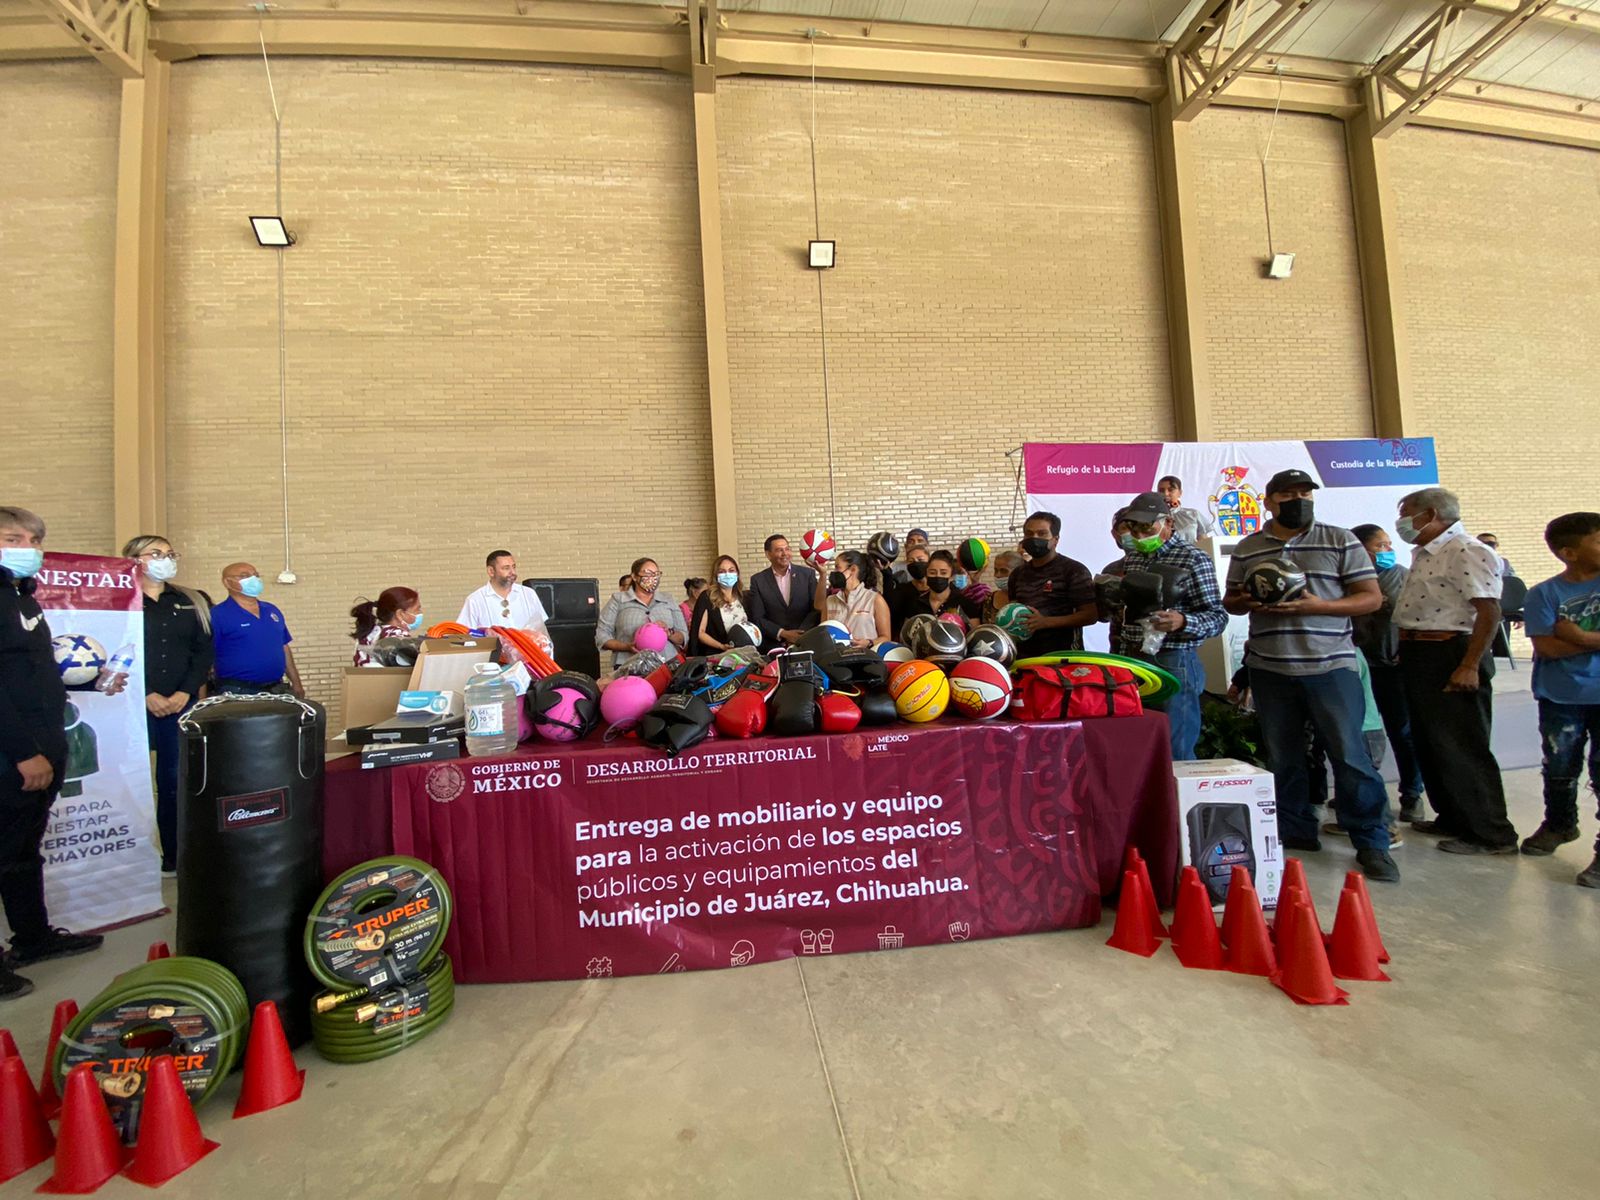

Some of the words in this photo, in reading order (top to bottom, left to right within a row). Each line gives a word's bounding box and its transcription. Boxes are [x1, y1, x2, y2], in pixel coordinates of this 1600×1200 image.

[1046, 464, 1079, 476] Refugio
[1081, 464, 1091, 474] de
[1093, 464, 1101, 474] la
[1103, 464, 1136, 474] Libertad
[1330, 460, 1364, 469] Custodia
[1365, 459, 1375, 468] de
[1377, 459, 1384, 468] la
[1386, 458, 1422, 469] República
[33, 569, 134, 589] NESTAR
[867, 744, 888, 752] LATE
[878, 733, 909, 743] MÉXICO
[471, 760, 541, 776] GOBIERNO
[543, 759, 561, 769] DE
[586, 754, 700, 777] DESARROLLO
[703, 746, 817, 768] TERRITORIAL
[472, 772, 562, 794] MÉXICO
[65, 799, 113, 817] PARA
[575, 817, 673, 841] Entrega
[680, 811, 711, 831] de
[717, 799, 837, 827] mobiliario
[842, 801, 856, 820] y
[862, 791, 943, 817] equipo
[45, 814, 109, 834] NESTAR
[41, 824, 129, 850] ERSONAS
[576, 849, 632, 876] para
[639, 843, 658, 863] la
[665, 833, 781, 861] activación
[787, 829, 816, 849] de
[822, 827, 856, 846] los
[861, 817, 962, 845] espacios
[49, 838, 137, 865] MAYORES
[577, 873, 678, 904] públicos
[683, 872, 697, 893] y
[703, 856, 876, 889] equipamientos
[882, 848, 918, 870] del
[578, 897, 701, 928] Municipio
[707, 894, 738, 916] de
[744, 888, 831, 914] Juárez,
[836, 876, 969, 904] Chihuahua.
[353, 896, 431, 938] TRUPER
[395, 941, 405, 950] 30
[108, 1053, 208, 1075] TRER
